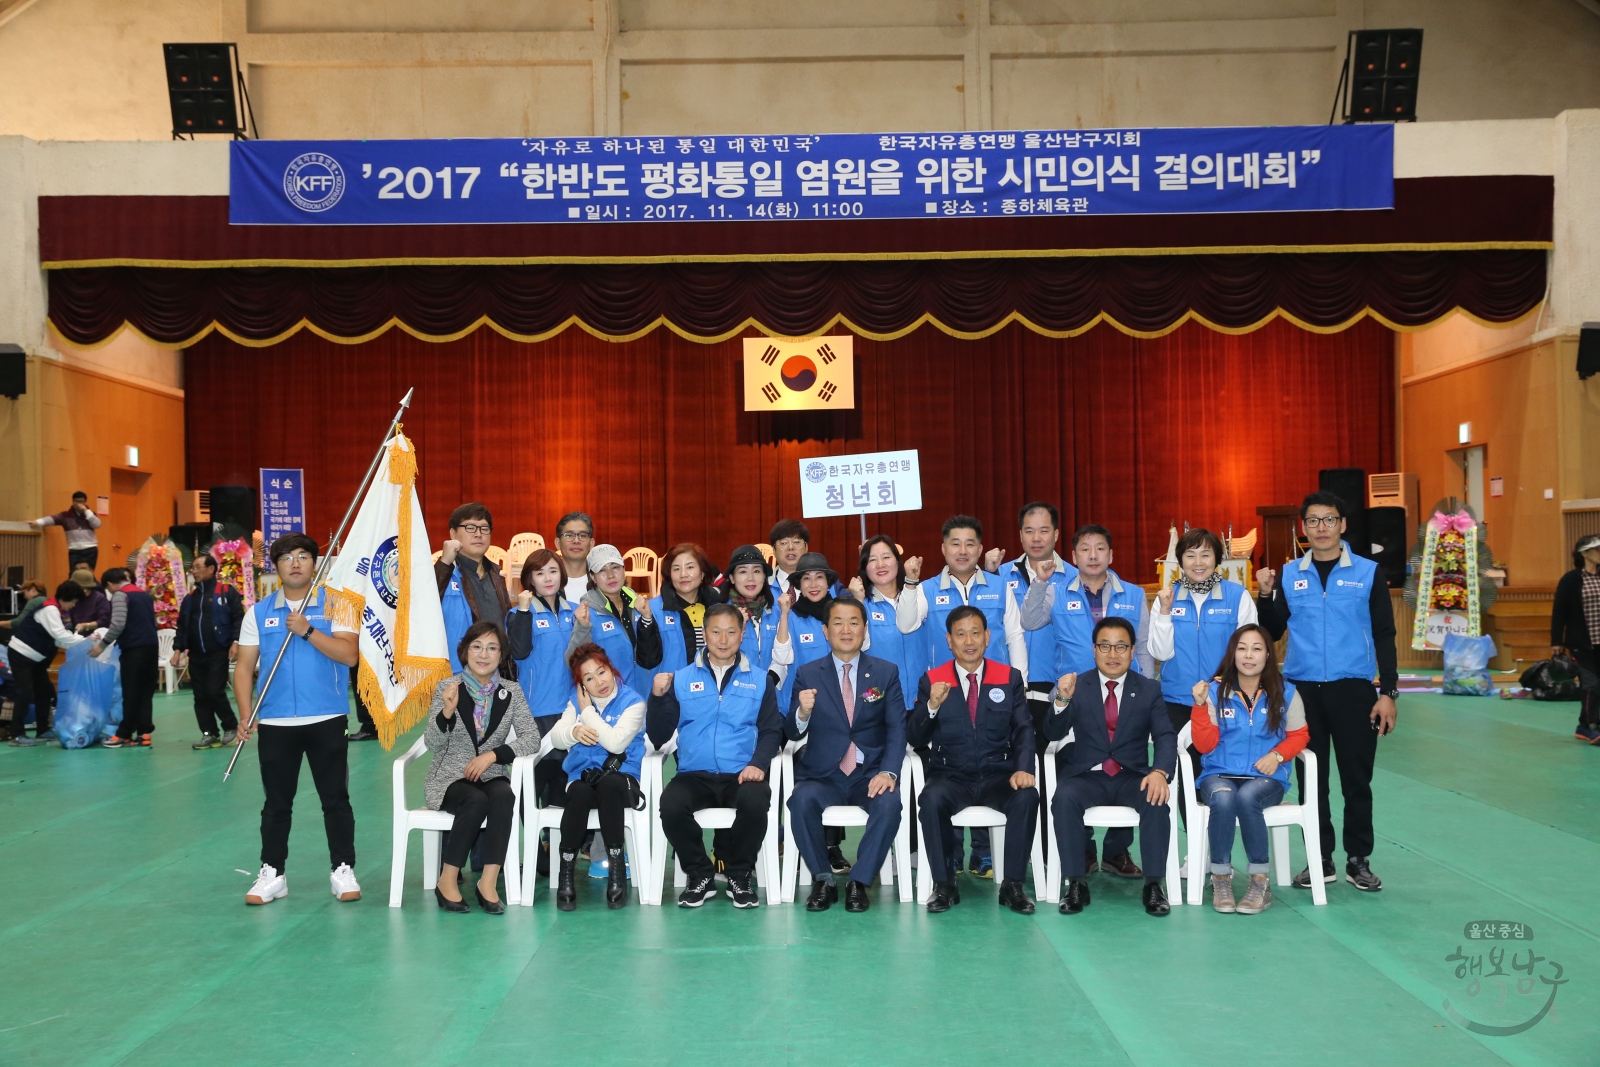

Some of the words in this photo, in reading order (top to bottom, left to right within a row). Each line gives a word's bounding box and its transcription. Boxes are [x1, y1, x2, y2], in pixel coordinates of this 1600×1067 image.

[602, 138, 666, 155] 하나된
[674, 137, 717, 154] 통일
[878, 133, 1016, 151] 한국자유총연맹
[1022, 131, 1141, 149] 울산남구지회
[296, 175, 333, 192] KFF
[641, 160, 783, 199] 평화통일
[796, 158, 903, 197] 염원을
[915, 157, 988, 195] 위한
[997, 154, 1140, 193] 시민의식
[292, 196, 322, 210] FREEDOM
[321, 175, 343, 208] FEDERATION
[746, 202, 800, 218] 14(화)
[812, 202, 864, 216] 11:00
[1000, 197, 1090, 215] 종하체육관
[828, 459, 911, 478] 한국자유총연맹
[825, 479, 897, 510] 청년회
